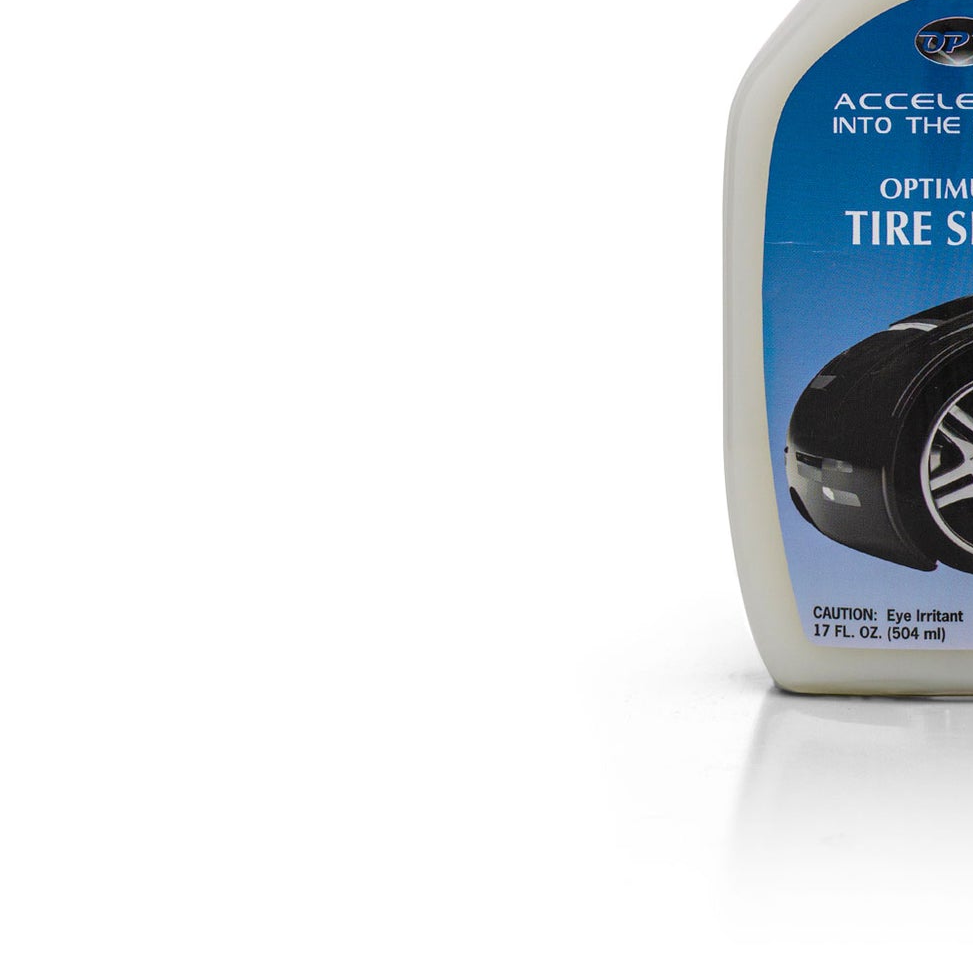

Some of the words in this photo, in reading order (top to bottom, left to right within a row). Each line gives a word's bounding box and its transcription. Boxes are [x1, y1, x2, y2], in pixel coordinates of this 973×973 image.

[833, 116, 892, 134] INTO
[905, 116, 961, 134] THE
[845, 210, 932, 245] TIRE
[813, 606, 877, 621] CAUTION:
[887, 609, 912, 624] Eye
[917, 609, 964, 622] Irritant
[814, 624, 830, 637] 17
[835, 625, 855, 638] FL.
[859, 626, 882, 639] OZ.
[887, 626, 919, 642] (504
[923, 627, 946, 643] ml)
